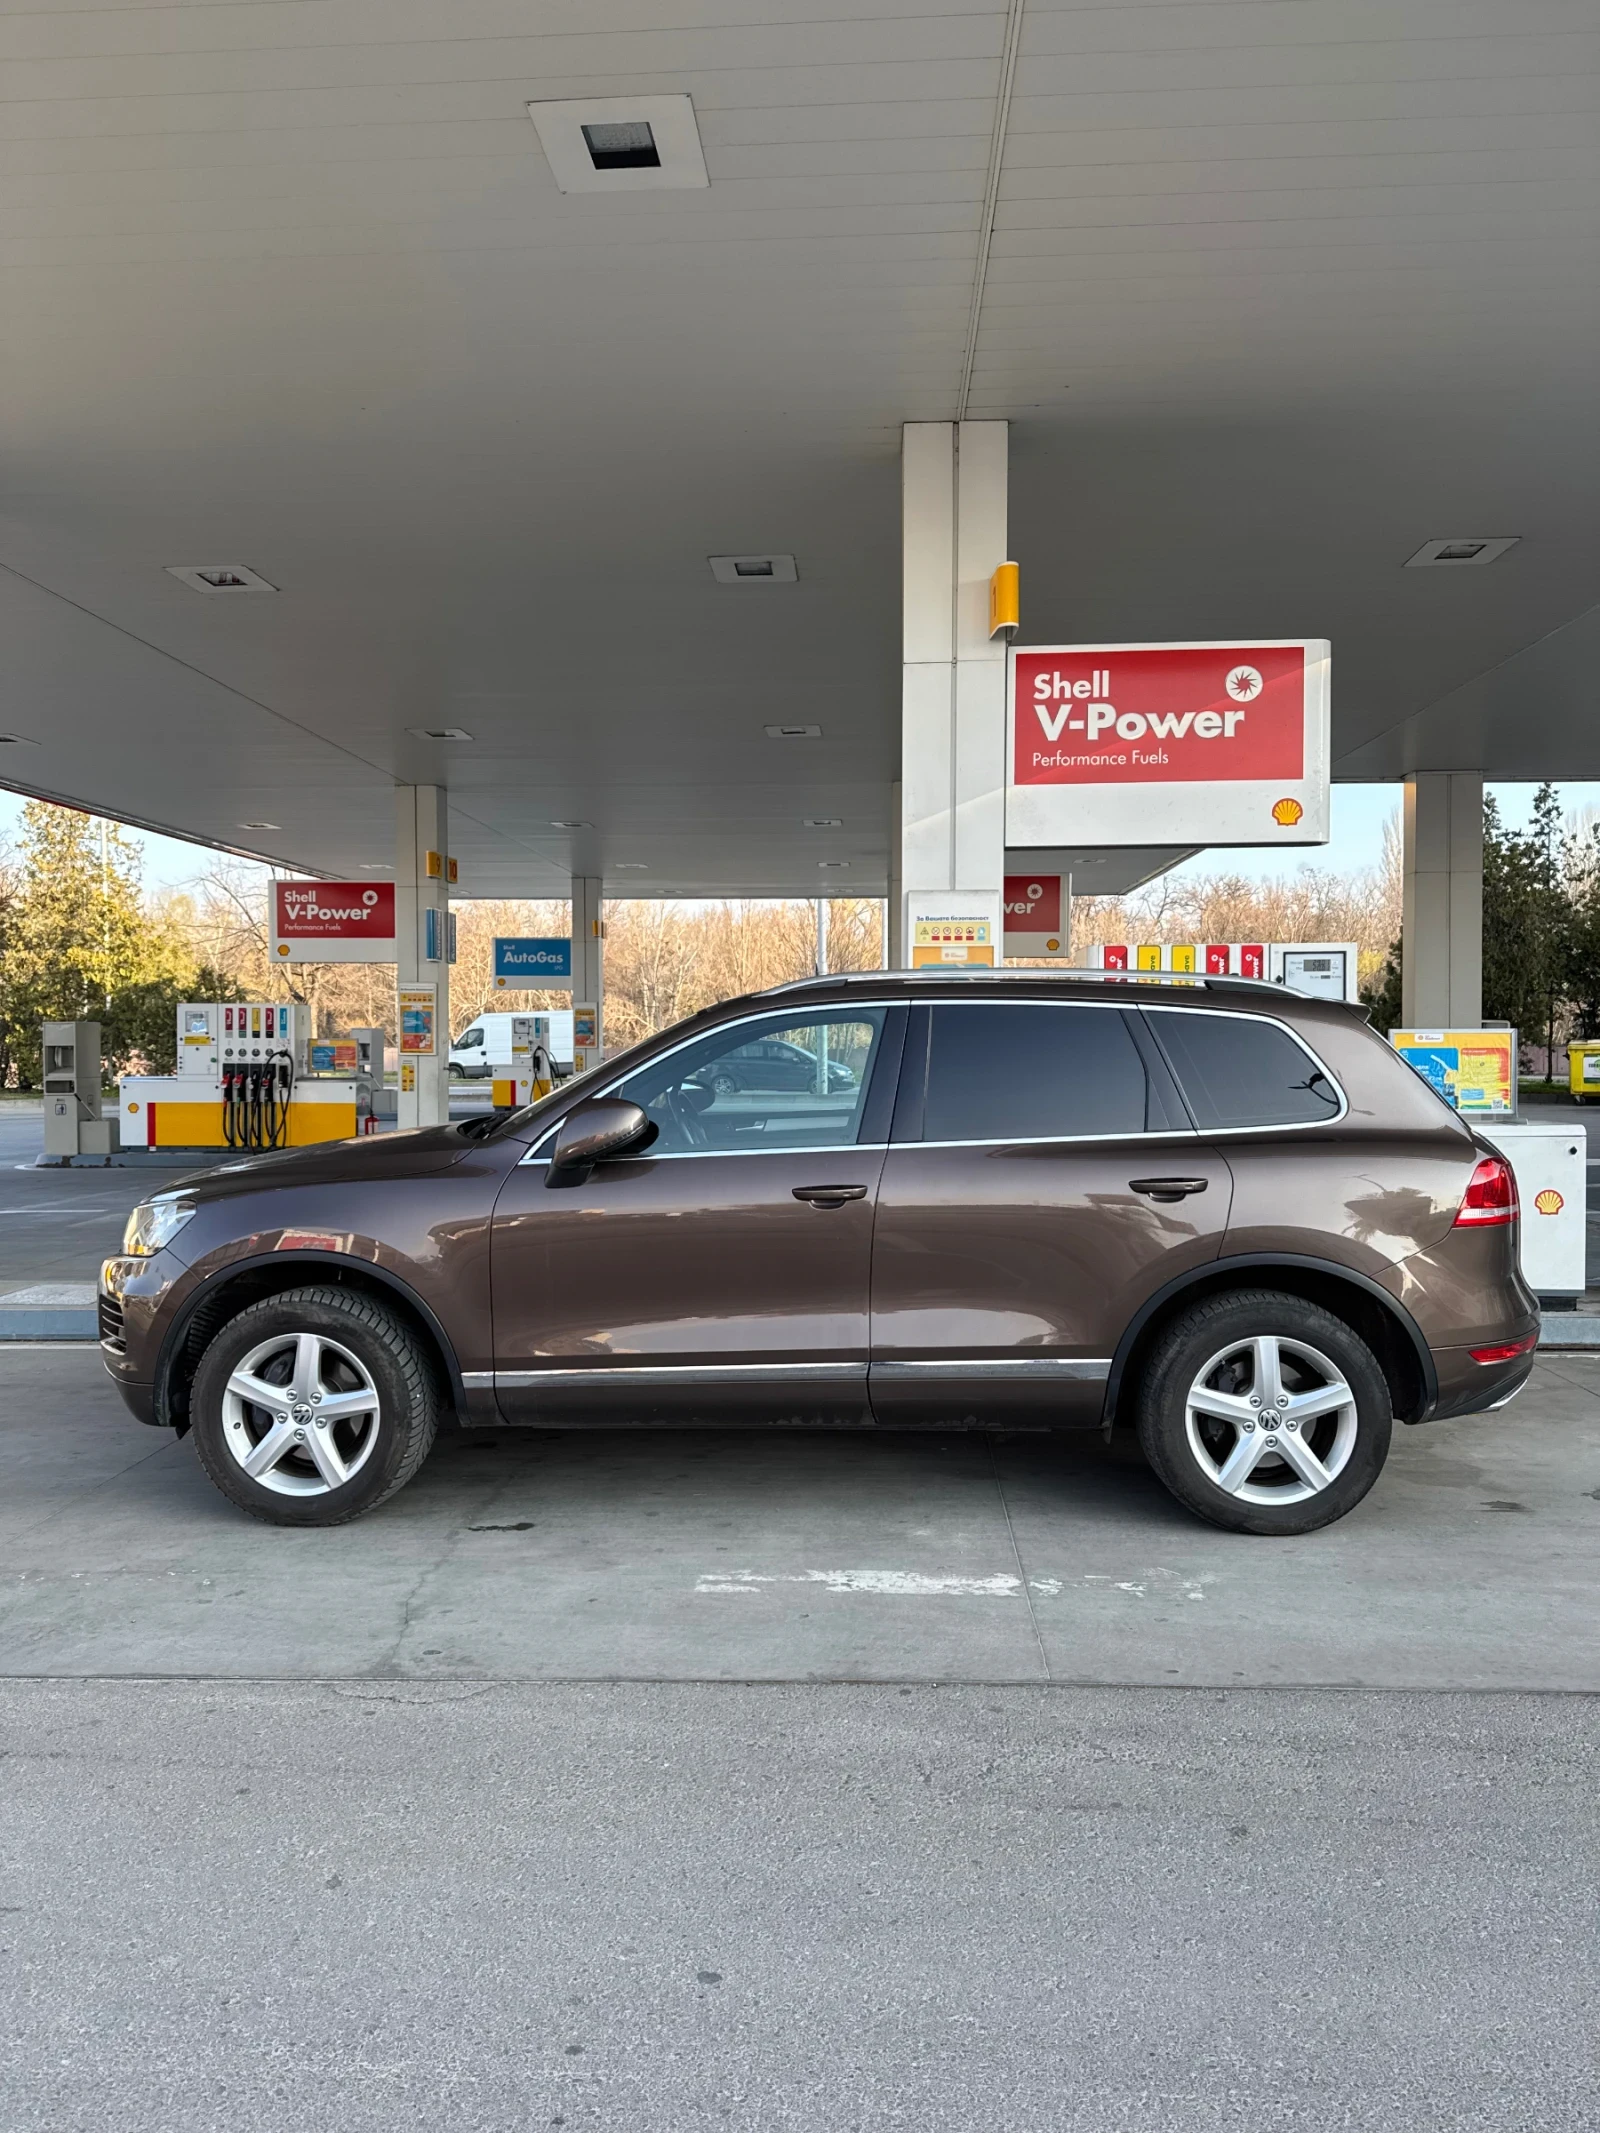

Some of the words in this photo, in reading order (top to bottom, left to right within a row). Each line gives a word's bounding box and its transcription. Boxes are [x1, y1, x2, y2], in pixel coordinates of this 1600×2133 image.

[1033, 670, 1110, 700] Shell
[1033, 703, 1246, 742] V-Power
[1033, 750, 1127, 767] Performance
[1132, 748, 1169, 765] Fuels
[284, 890, 316, 903] Shell
[284, 904, 371, 920] V-Power
[284, 923, 324, 931] Performance
[325, 923, 341, 931] Fuels
[503, 951, 564, 963] AutoGas
